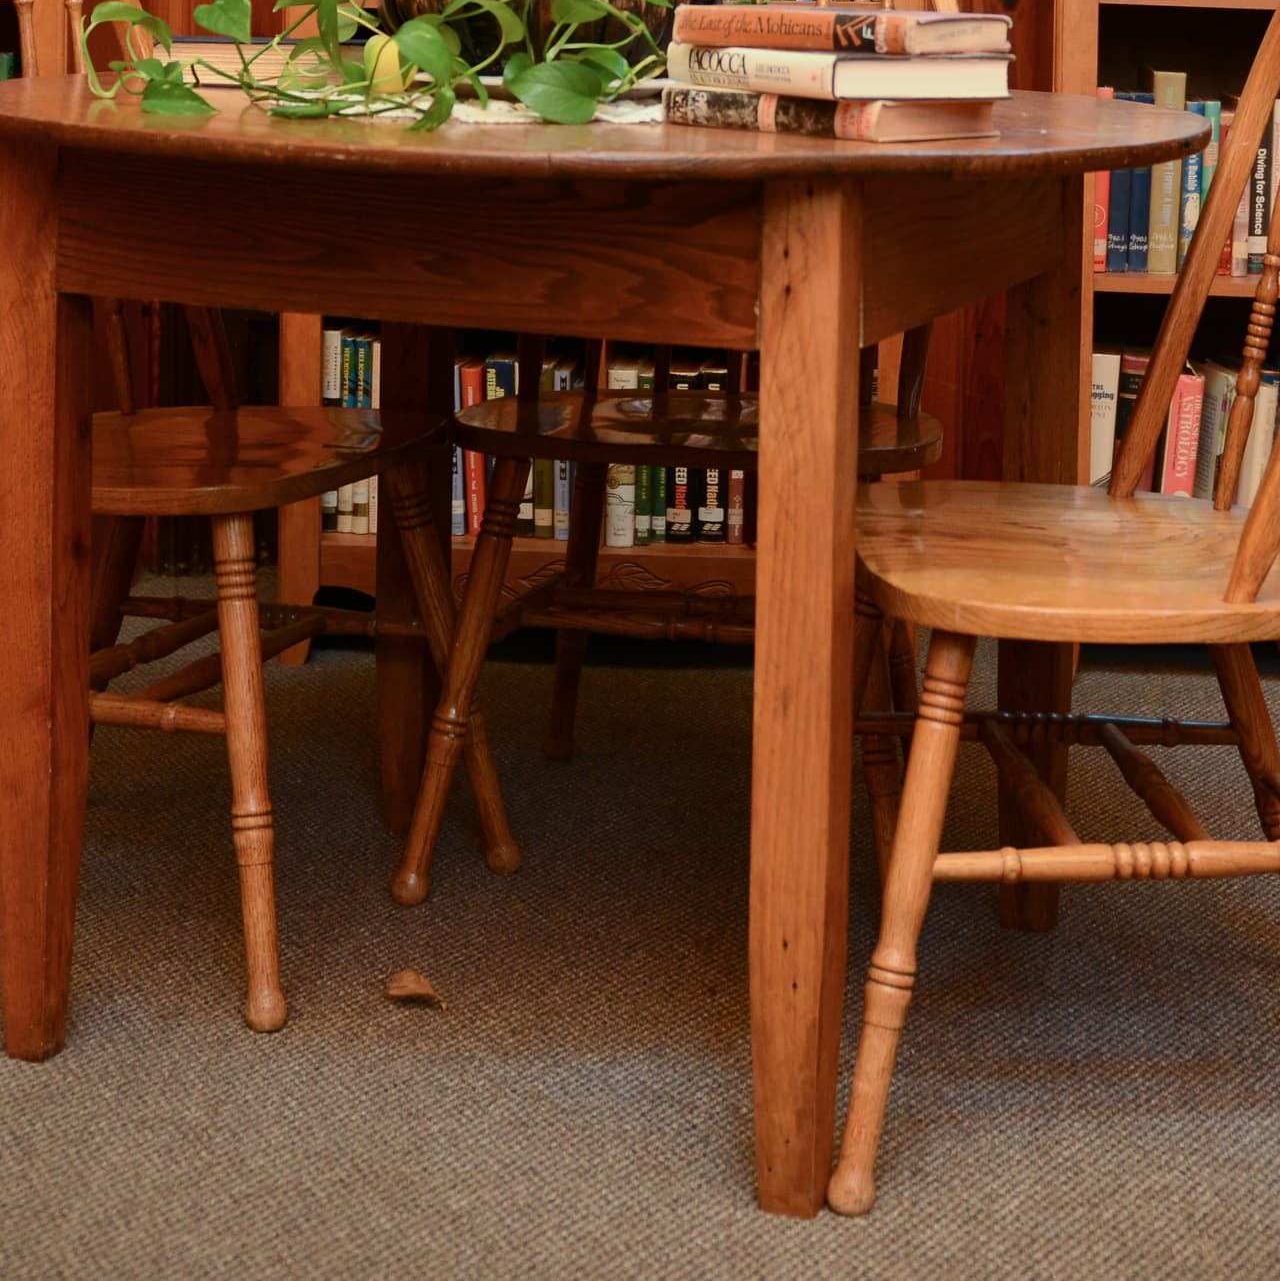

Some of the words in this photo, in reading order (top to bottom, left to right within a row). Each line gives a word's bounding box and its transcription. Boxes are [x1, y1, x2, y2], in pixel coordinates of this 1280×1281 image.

[698, 14, 720, 36] Last
[720, 15, 734, 39] of
[733, 17, 754, 36] the
[754, 16, 824, 38] Mohicans
[688, 48, 747, 76] IACOCCA
[1254, 147, 1267, 179] Diving
[1254, 180, 1267, 195] for
[1254, 196, 1267, 235] Science
[342, 347, 351, 402] HELICOPTERS
[356, 347, 366, 402] HELICOPTERS
[1175, 393, 1195, 479] ASTROLOGY
[1192, 411, 1202, 438] CASE
[1190, 440, 1199, 461] FOR
